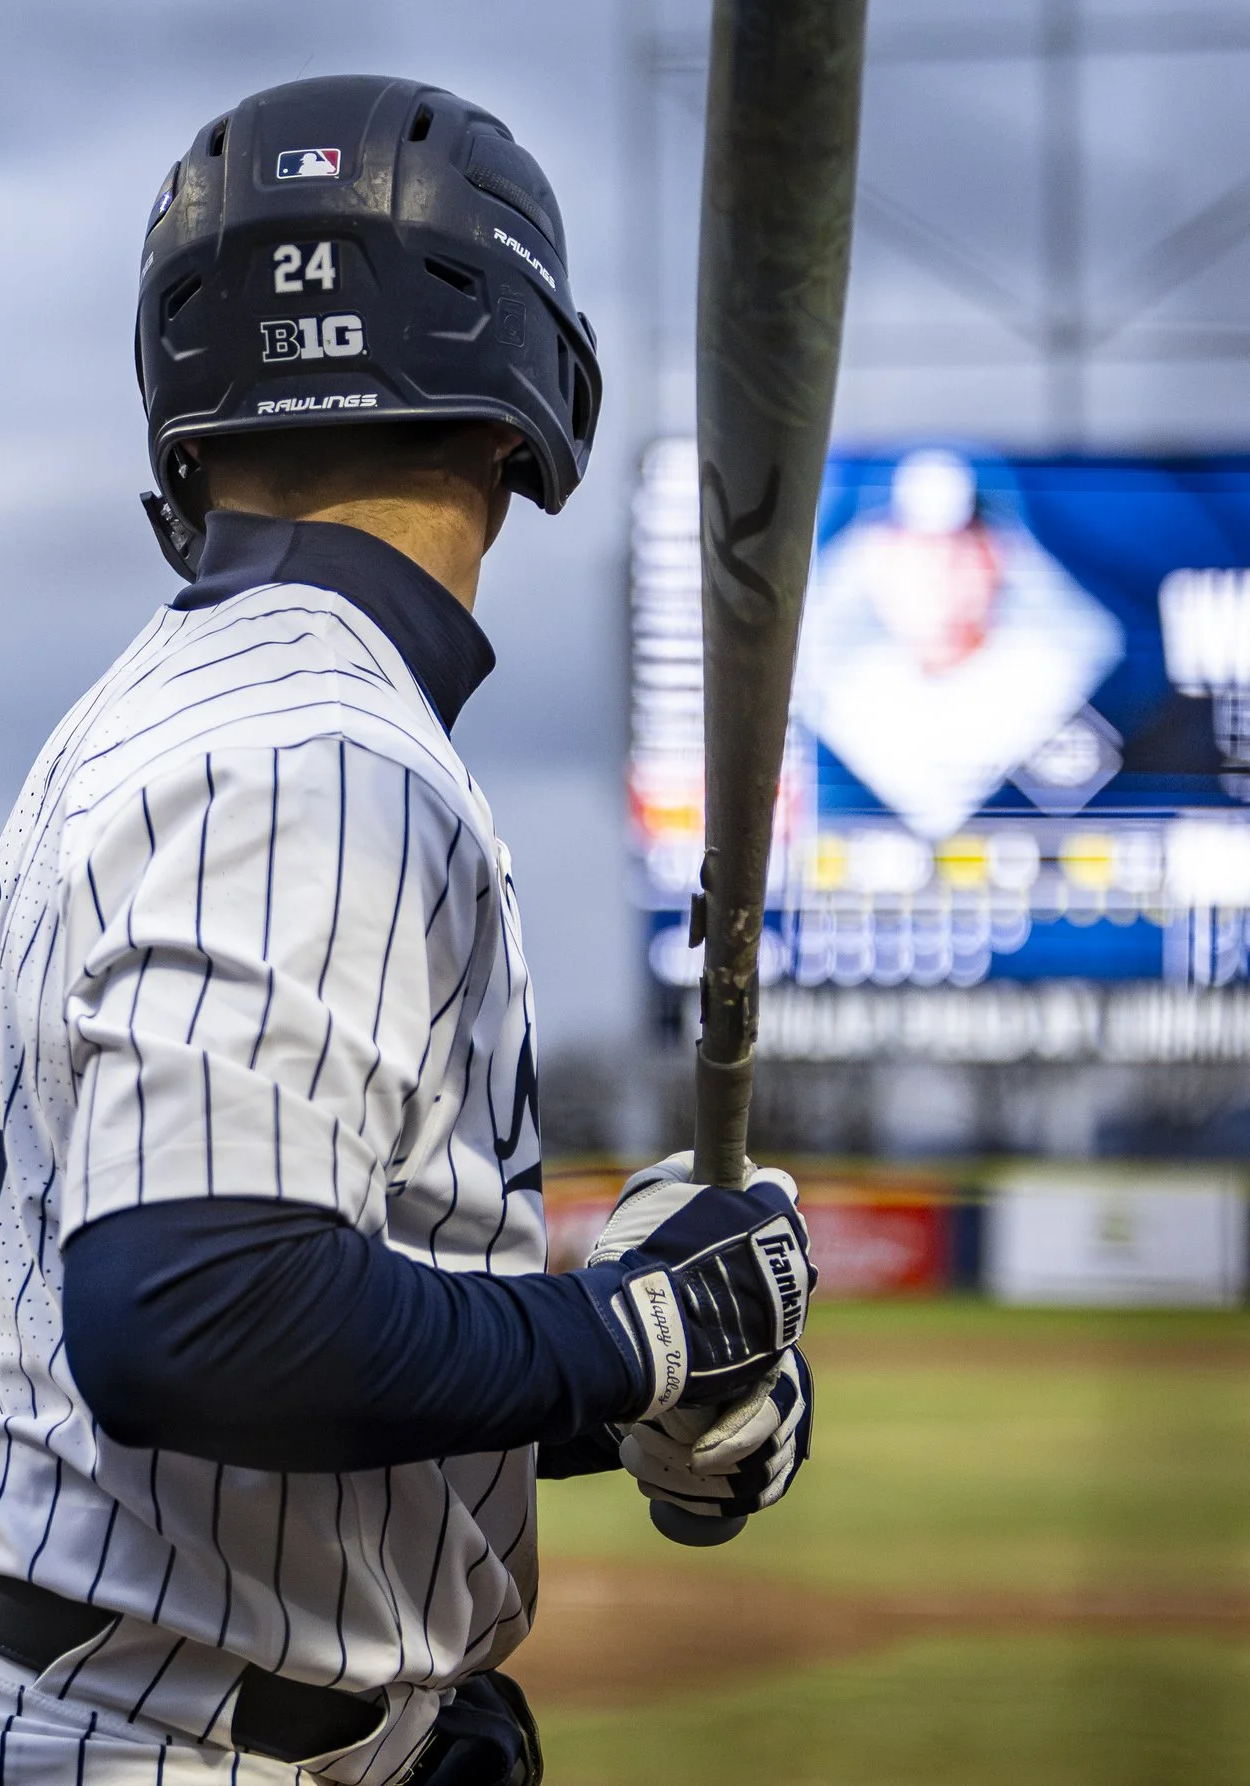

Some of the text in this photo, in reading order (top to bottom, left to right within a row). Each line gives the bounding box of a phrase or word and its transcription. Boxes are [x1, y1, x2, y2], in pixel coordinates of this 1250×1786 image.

[273, 241, 336, 293] 24
[257, 394, 378, 414] RAWLINGS
[644, 1286, 670, 1347] Happy
